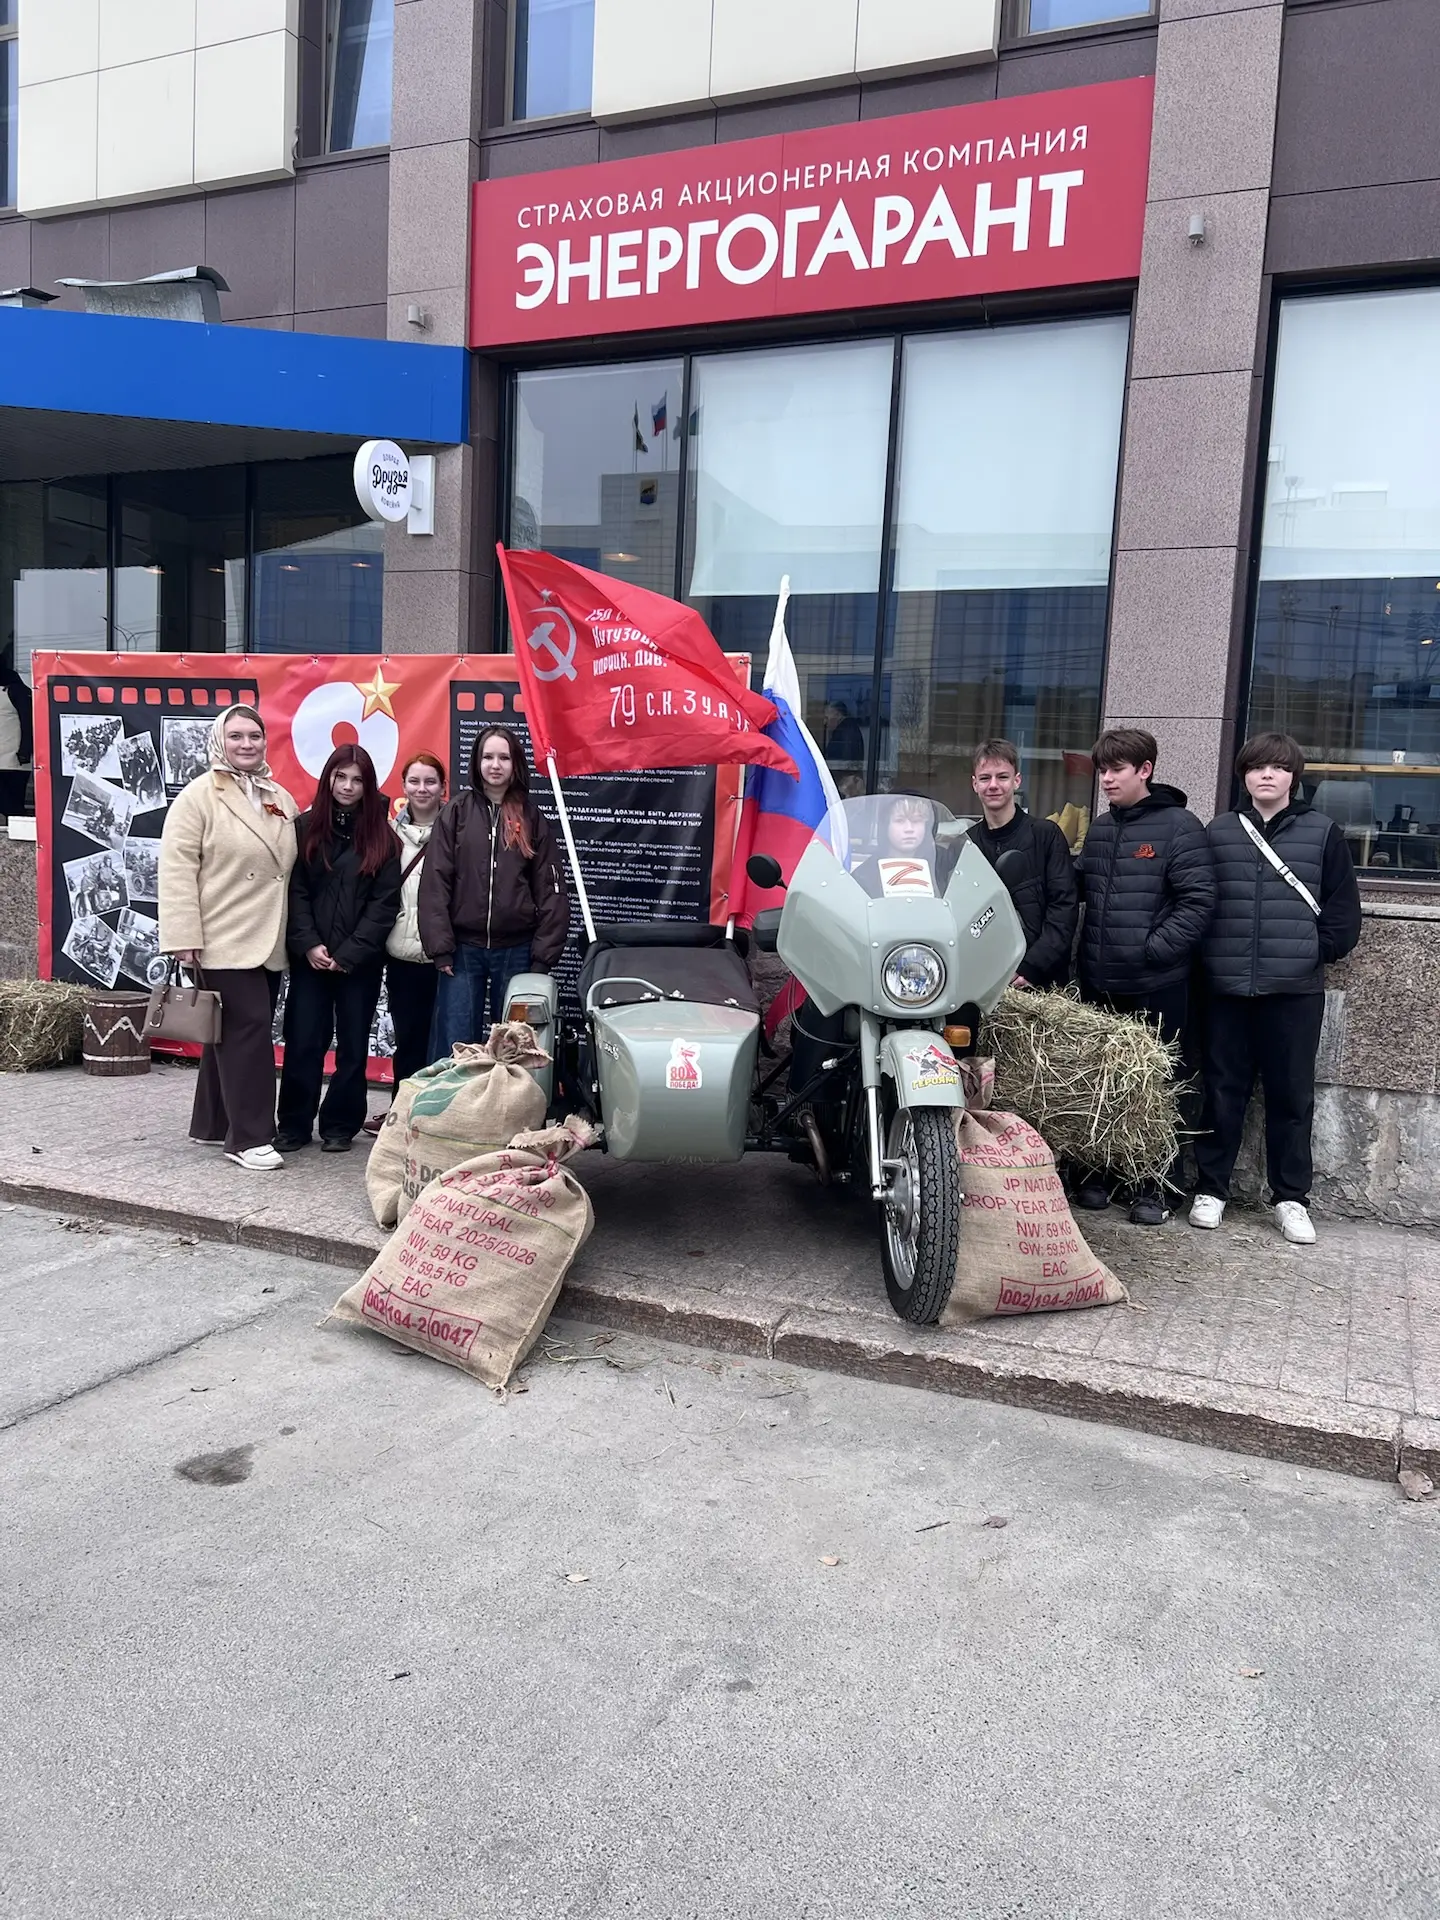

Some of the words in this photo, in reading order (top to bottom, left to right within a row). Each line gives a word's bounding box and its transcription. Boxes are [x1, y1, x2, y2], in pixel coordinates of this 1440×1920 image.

[517, 188, 664, 229] СТРАХОВАЯ
[678, 155, 891, 206] АКЦИОНЕРНАЯ
[903, 125, 1088, 174] КОМПАНИЯ
[515, 170, 1085, 309] ЭНЕРГОГАРАНТ
[372, 464, 409, 495] Друзья
[610, 684, 636, 728] 79
[683, 689, 697, 715] 3
[978, 906, 995, 930] URAL
[670, 1066, 686, 1080] 80
[962, 1144, 1024, 1158] RABICA
[1003, 1178, 1021, 1192] JP
[443, 1198, 513, 1234] NATURAL
[1010, 1198, 1049, 1215] YEAR
[418, 1208, 454, 1236] YEAR
[456, 1226, 538, 1266] 2025/2026
[1016, 1220, 1045, 1239] NW:
[1046, 1223, 1059, 1238] 59
[1060, 1220, 1072, 1236] KG
[406, 1230, 430, 1254] NW:
[430, 1243, 451, 1260] 59
[450, 1250, 479, 1271] KG
[1018, 1241, 1045, 1257] GW:
[1066, 1239, 1079, 1253] KG
[398, 1249, 418, 1269] GW:
[417, 1261, 444, 1280] 59,5
[443, 1267, 468, 1288] KG
[1042, 1260, 1069, 1278] EAC
[401, 1275, 433, 1298] EAC
[1002, 1289, 1031, 1307] 002
[1034, 1291, 1074, 1309] 194-2
[387, 1306, 427, 1334] 194-2
[430, 1320, 474, 1348] 0047
